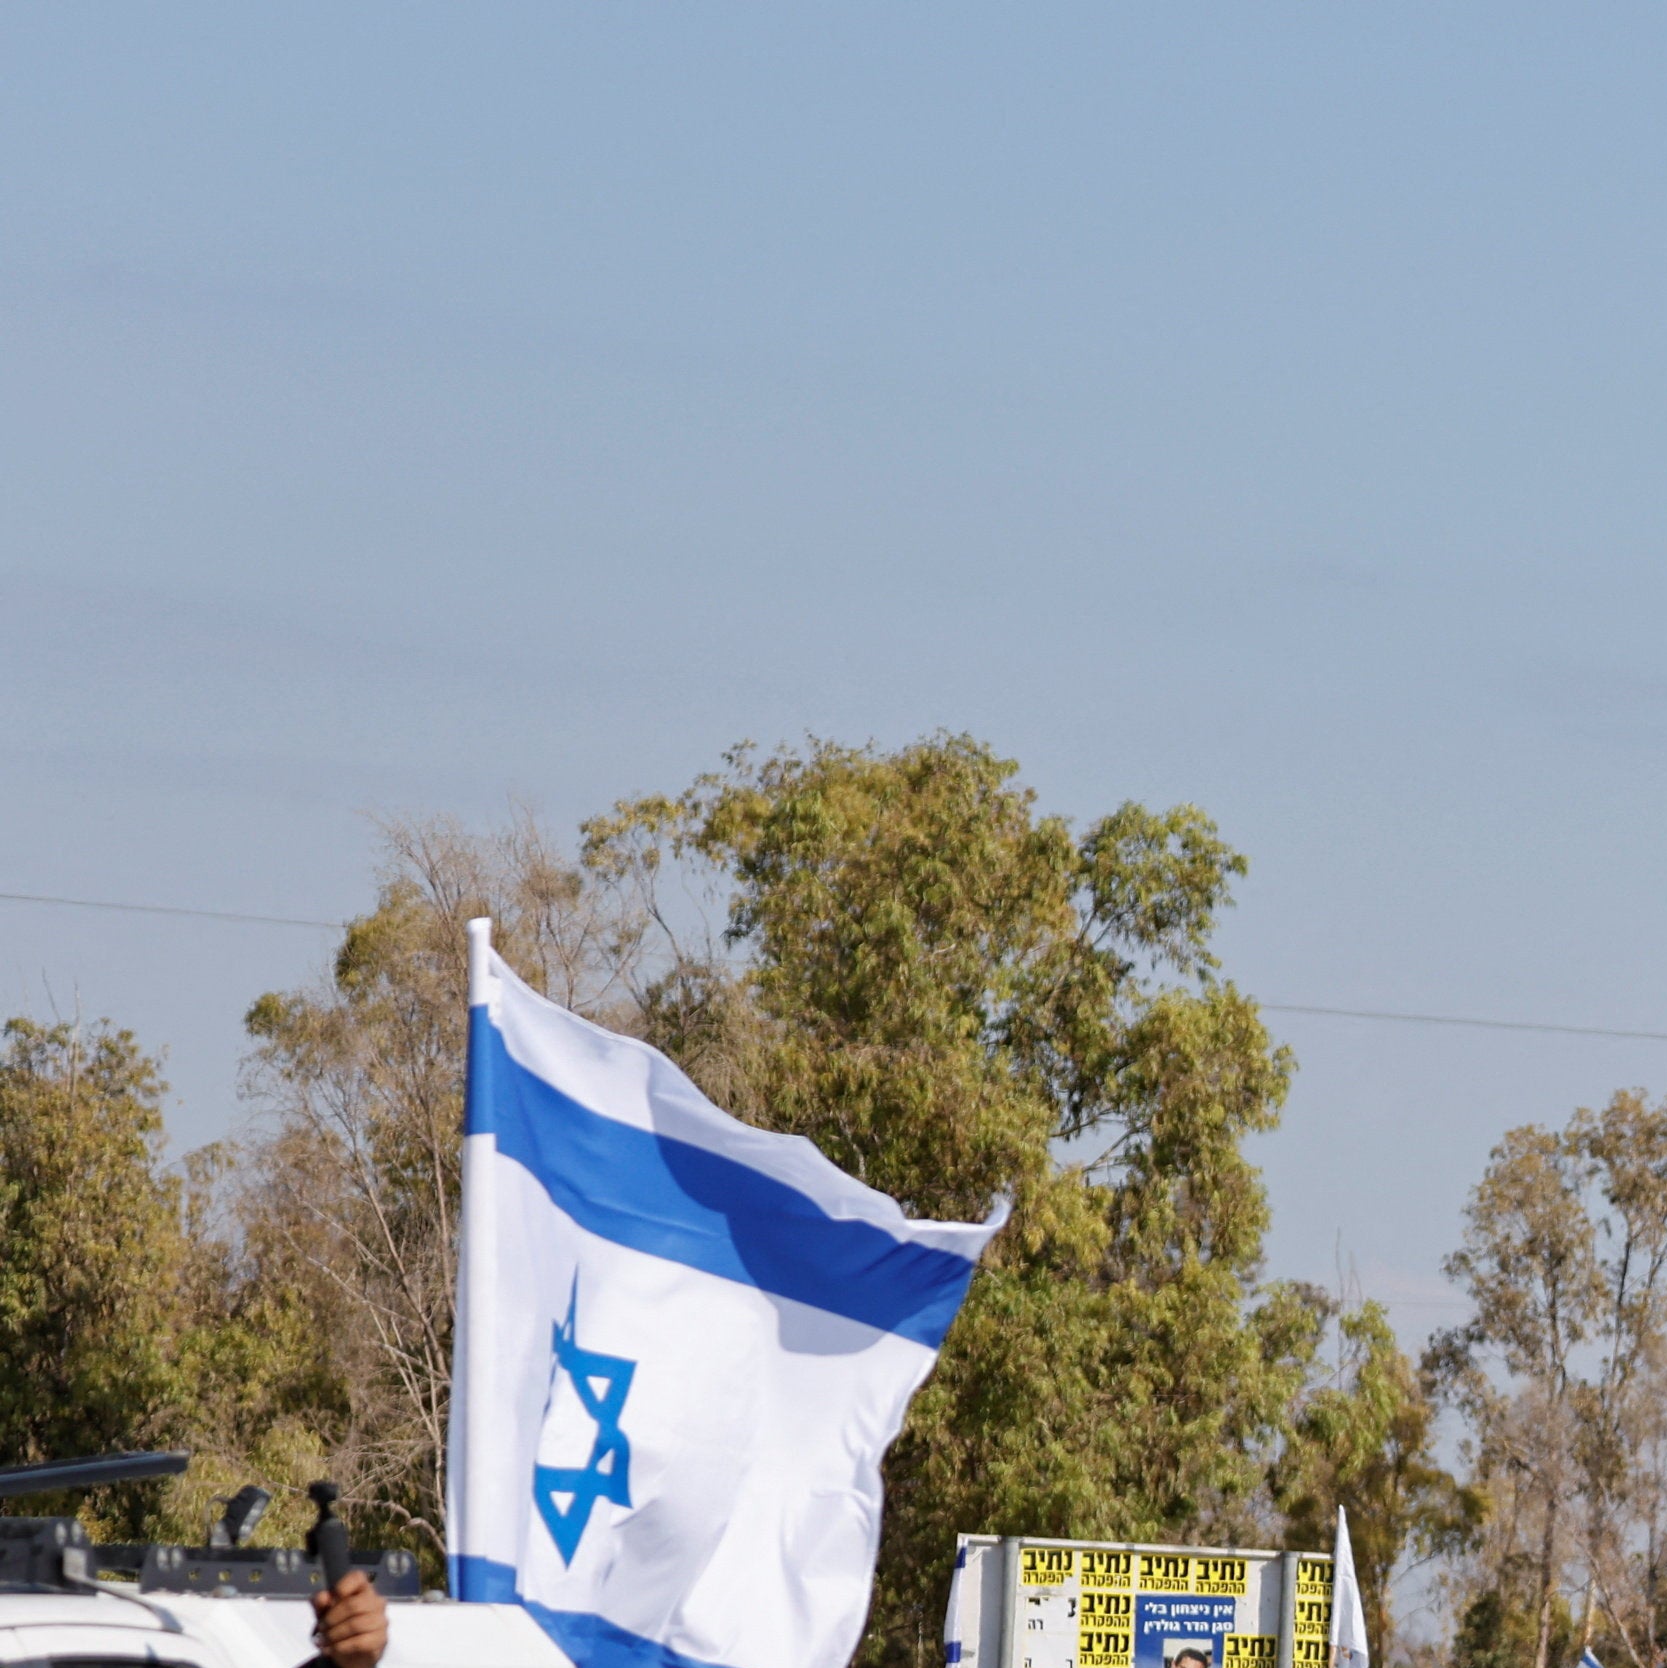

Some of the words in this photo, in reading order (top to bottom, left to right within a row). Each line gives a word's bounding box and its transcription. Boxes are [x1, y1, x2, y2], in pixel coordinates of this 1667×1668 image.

[1023, 1550, 1073, 1570] נתיב
[1082, 1552, 1131, 1574] נתיב
[1141, 1555, 1190, 1578] נתיב
[1197, 1560, 1245, 1580] נתיב
[1297, 1561, 1334, 1583] נתי
[1023, 1572, 1073, 1584] הפקרה
[1081, 1574, 1131, 1587] ההפקרה
[1140, 1578, 1188, 1591] ההפקרה
[1196, 1581, 1245, 1594] ההפקרה
[1082, 1593, 1131, 1614] נתיב
[1144, 1602, 1167, 1615] בלי
[1171, 1604, 1210, 1618] ניצחון
[1213, 1604, 1233, 1618] אין
[1296, 1601, 1332, 1622] נתי
[1080, 1614, 1130, 1628] ההפקרה
[1143, 1619, 1180, 1635] גולדין
[1183, 1621, 1209, 1633] הדר
[1212, 1621, 1234, 1635] סגן
[1080, 1631, 1129, 1653] נתיב
[1227, 1637, 1276, 1657] נתיב
[1293, 1640, 1330, 1660] נתי
[1079, 1653, 1129, 1666] ההפקרה
